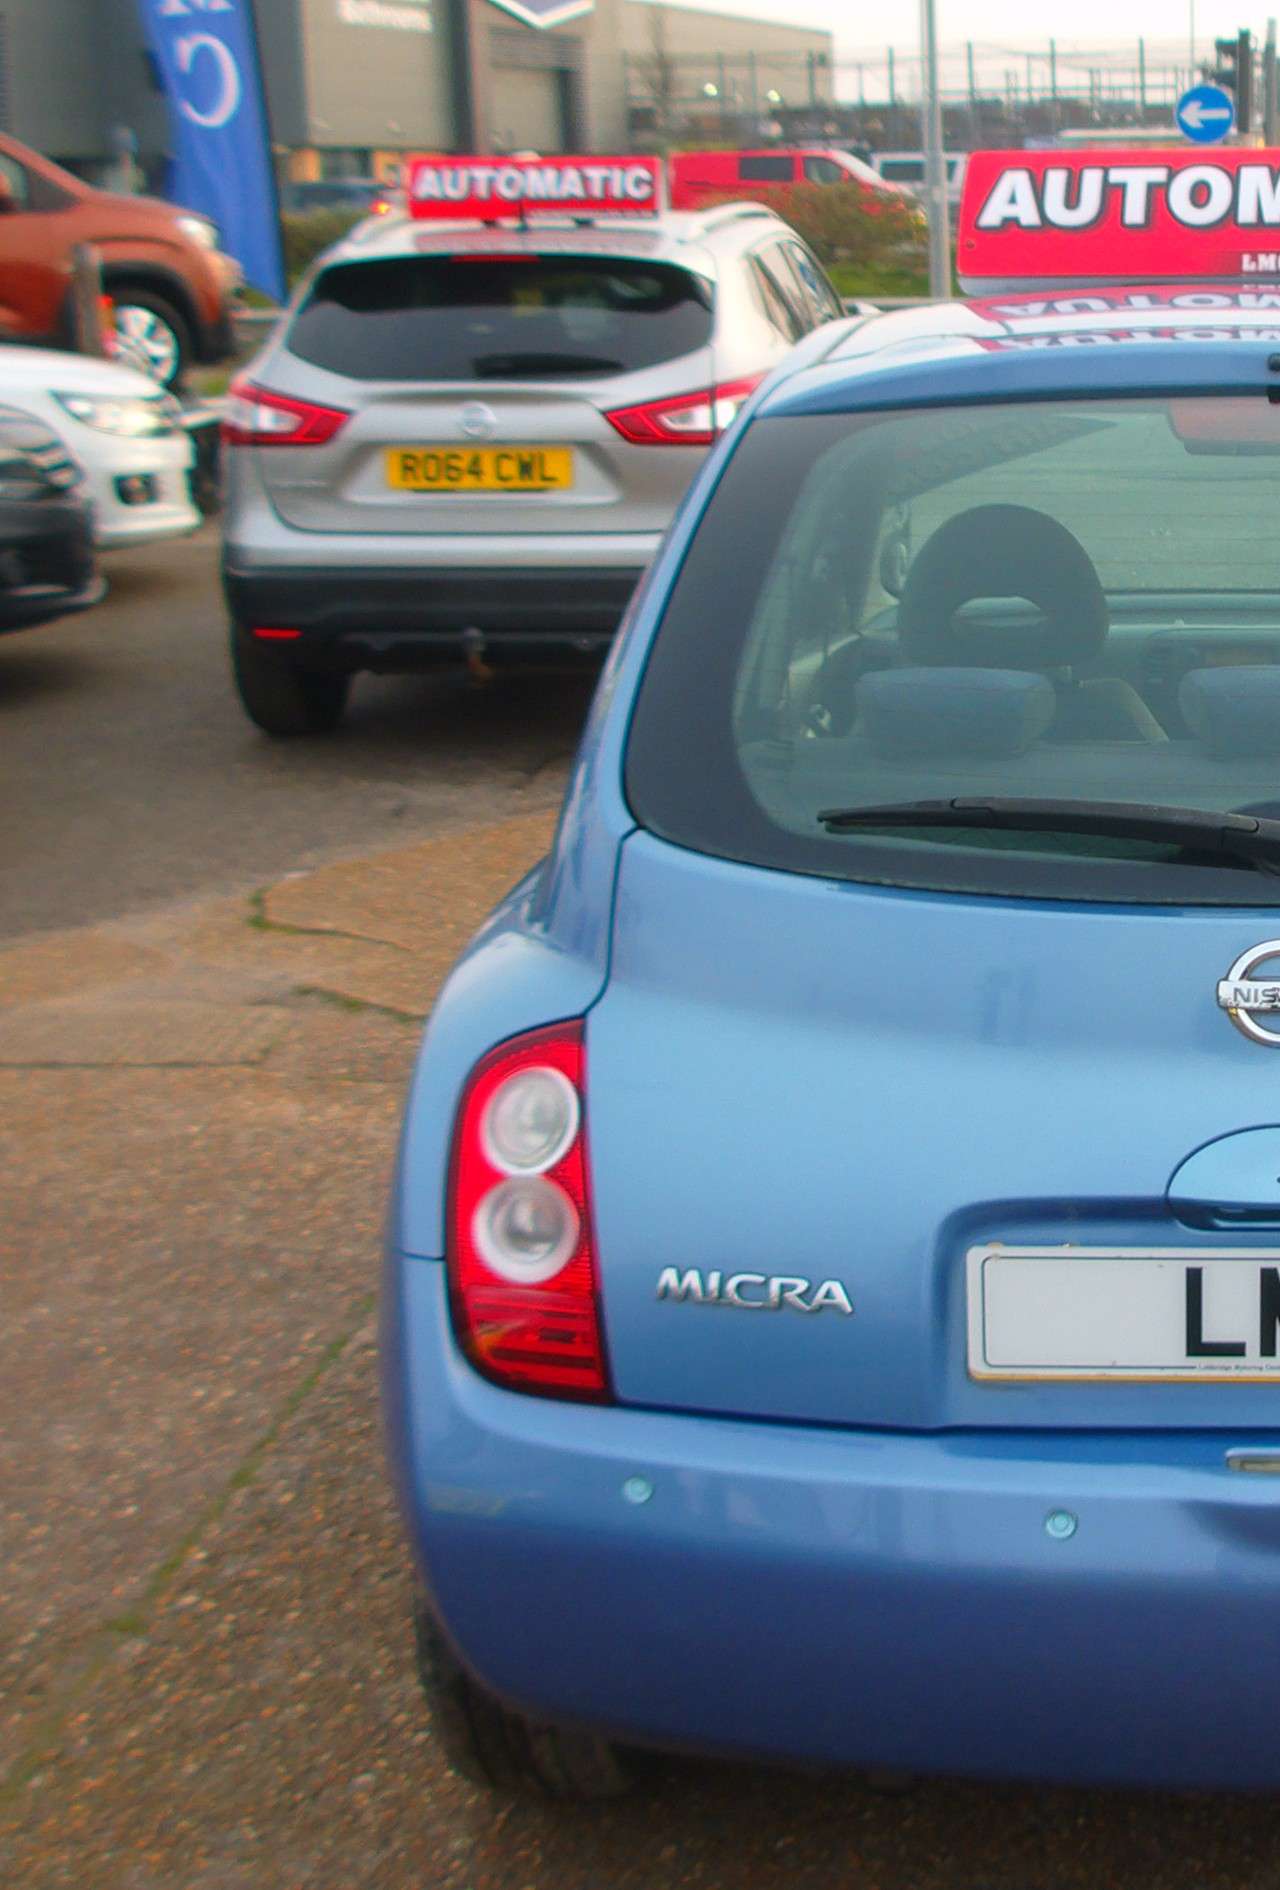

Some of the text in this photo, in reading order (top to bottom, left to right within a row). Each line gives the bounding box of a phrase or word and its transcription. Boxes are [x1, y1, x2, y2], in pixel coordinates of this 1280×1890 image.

[412, 165, 654, 200] AUTOMATIC
[495, 452, 558, 482] CWL
[656, 1266, 853, 1314] MICRA
